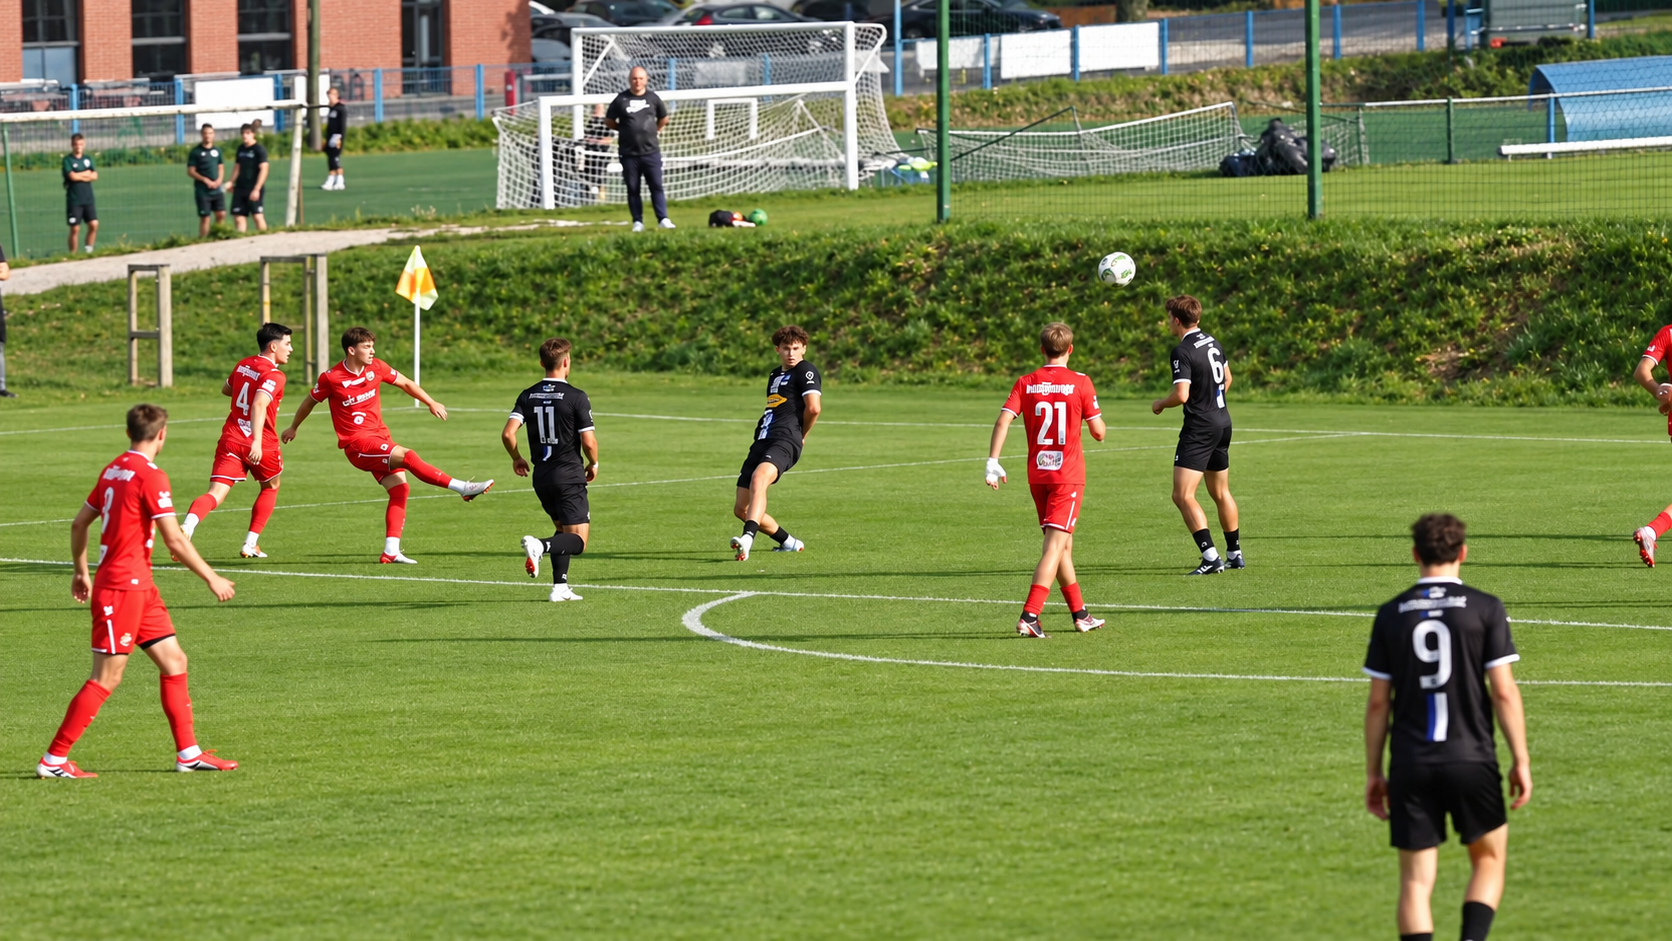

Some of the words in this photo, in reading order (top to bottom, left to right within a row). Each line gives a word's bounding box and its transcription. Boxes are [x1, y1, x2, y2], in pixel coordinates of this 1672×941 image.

[1207, 347, 1225, 384] 6
[236, 381, 250, 416] 4
[533, 406, 559, 445] 11
[1035, 401, 1067, 446] 21
[1412, 619, 1453, 689] 9
